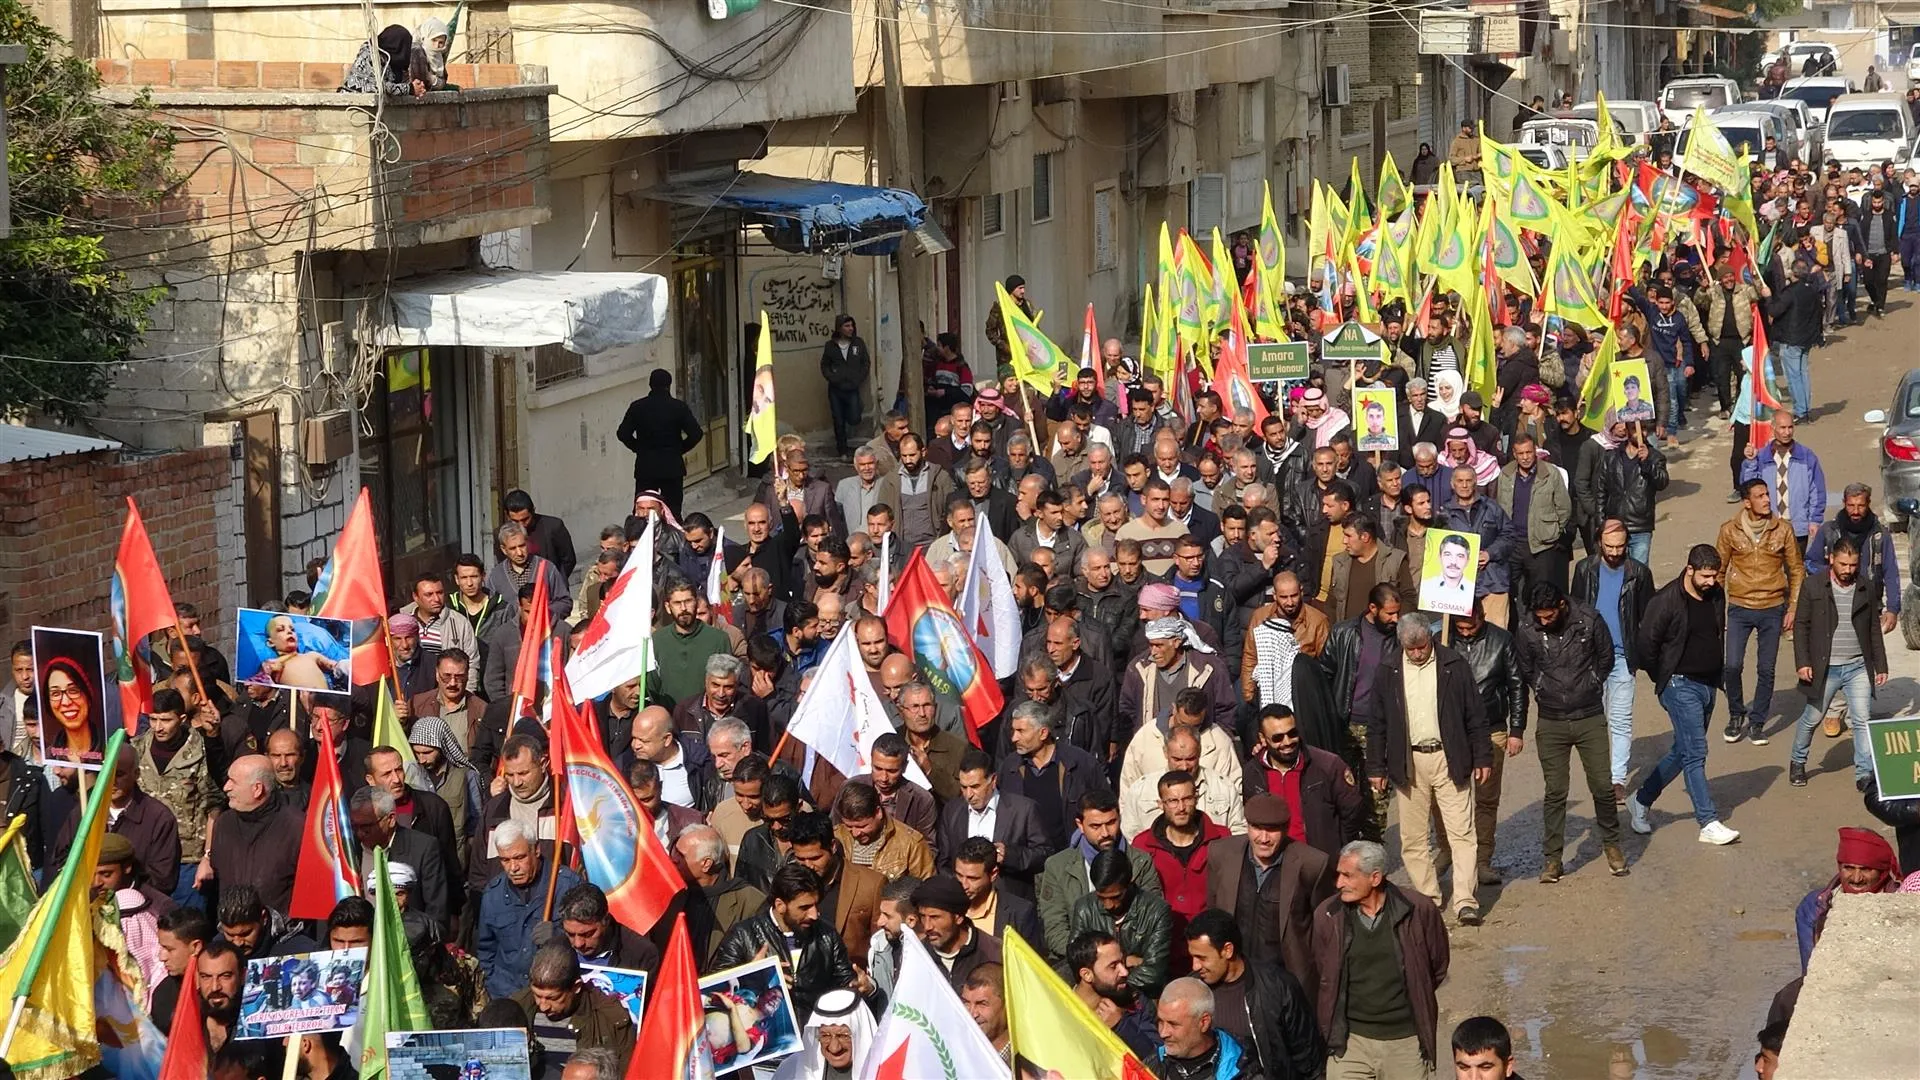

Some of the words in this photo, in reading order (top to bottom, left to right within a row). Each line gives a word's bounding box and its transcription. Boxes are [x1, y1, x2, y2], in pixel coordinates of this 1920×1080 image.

[1344, 328, 1358, 341] NA
[1261, 351, 1294, 361] Amara
[1262, 366, 1275, 374] our
[1276, 364, 1304, 374] Honour
[1884, 730, 1912, 755] JIN
